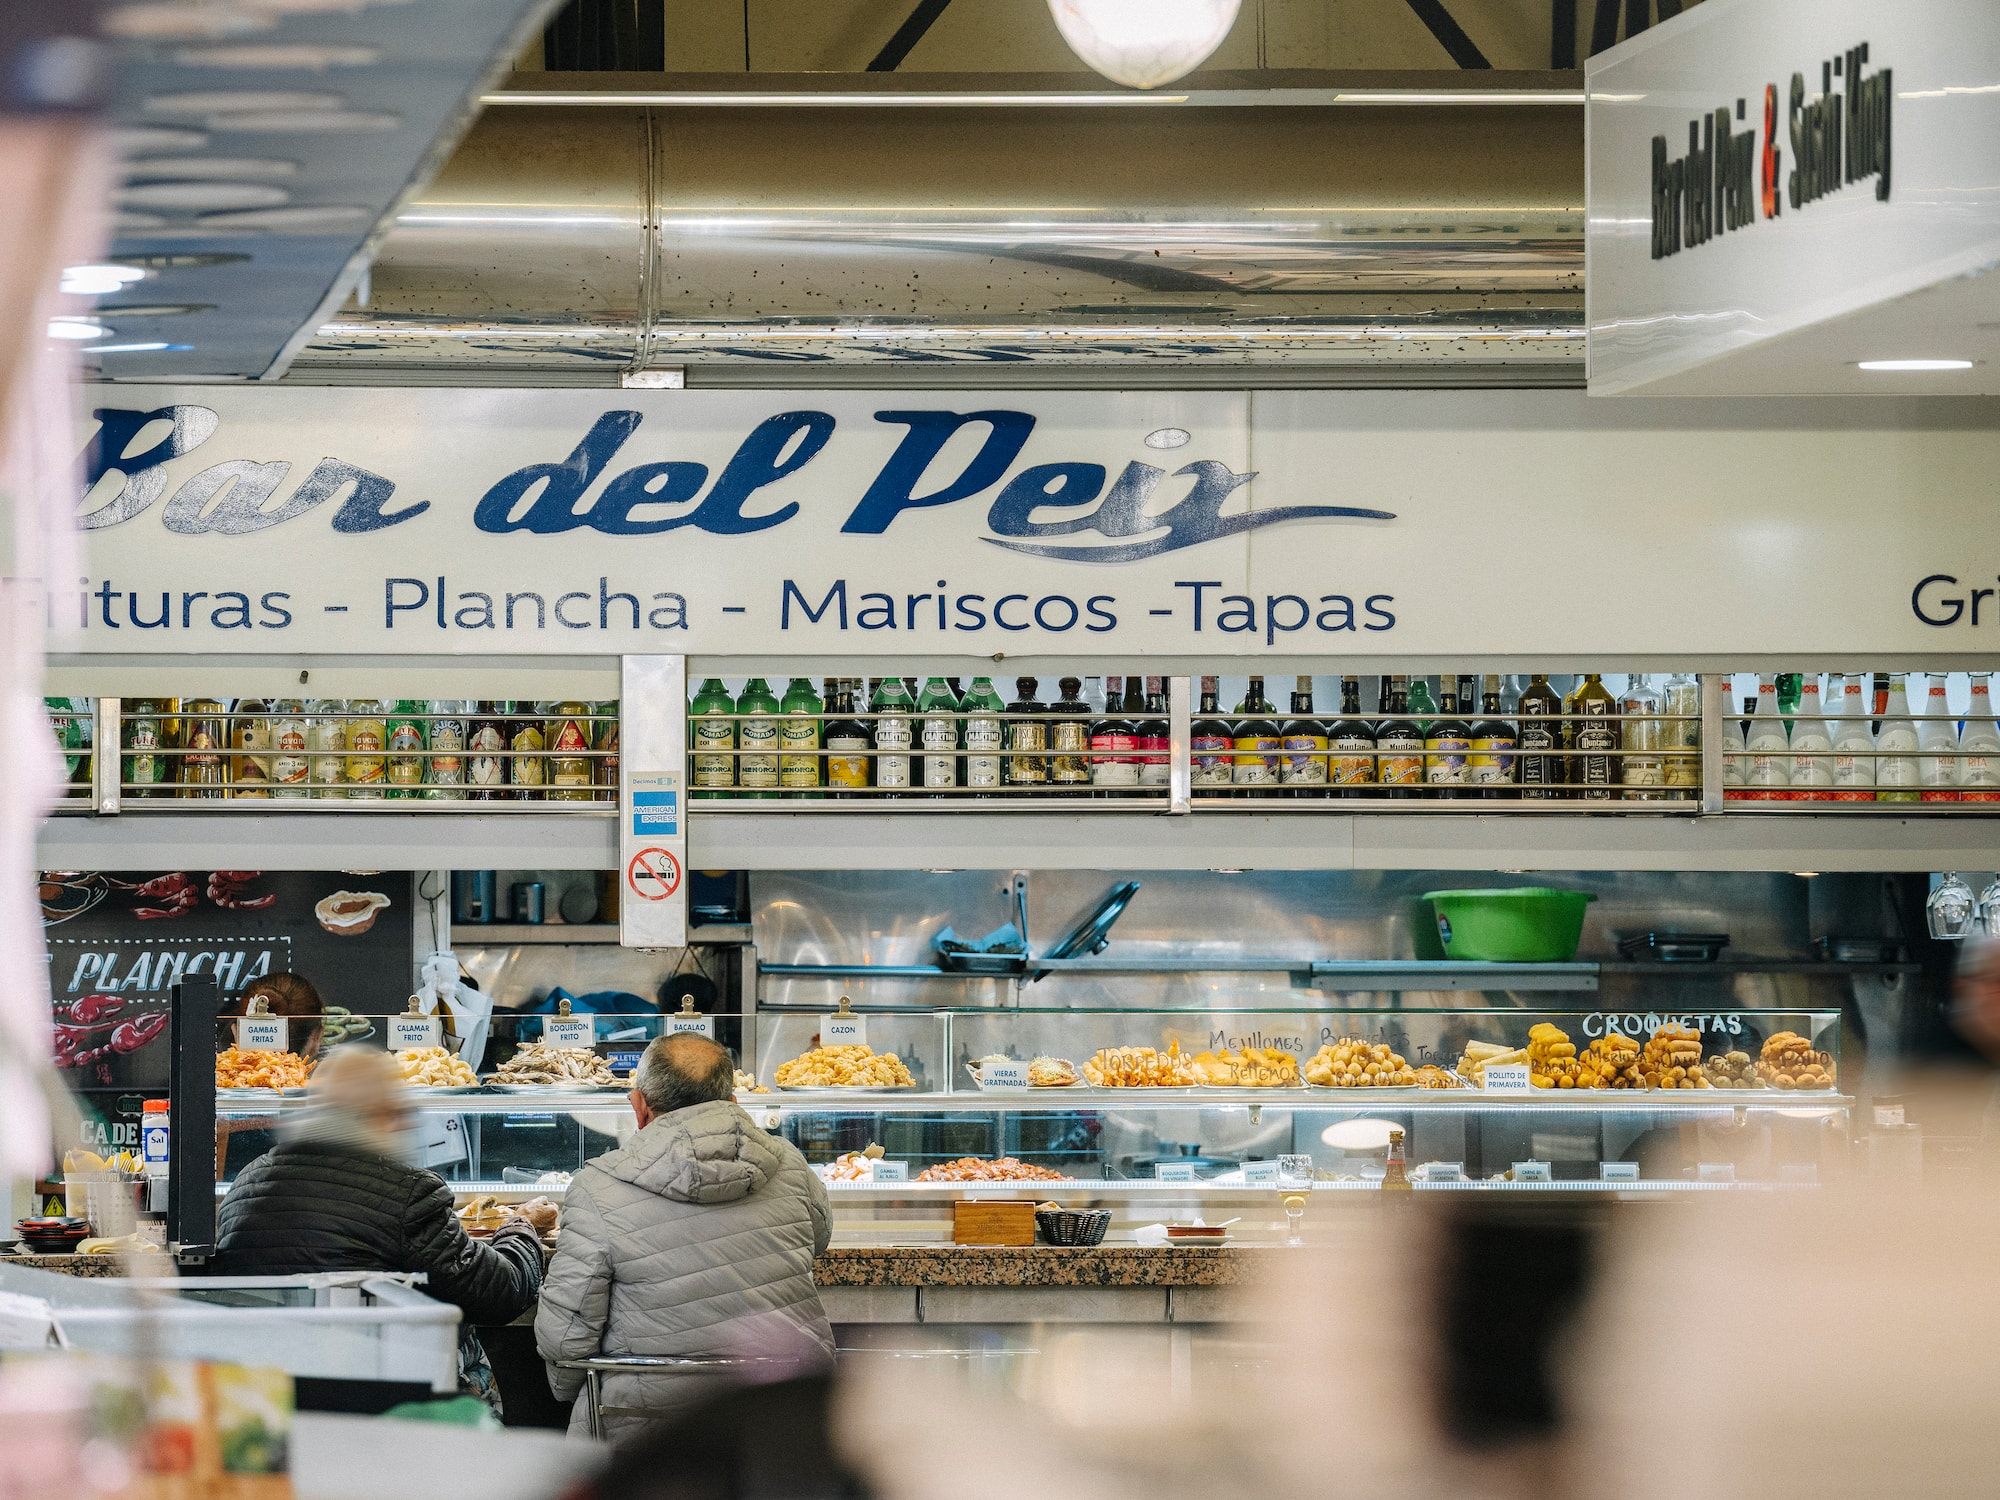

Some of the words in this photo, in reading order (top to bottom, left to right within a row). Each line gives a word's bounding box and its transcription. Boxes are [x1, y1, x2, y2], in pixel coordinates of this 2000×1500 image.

[1761, 82, 1781, 219] &
[73, 403, 430, 534] Bar
[473, 408, 837, 535] del
[839, 408, 1398, 564] Peix
[385, 576, 689, 631] Plancha
[780, 578, 1118, 632] Mariscos
[432, 720, 462, 738] BRUGAL
[878, 731, 910, 741] MARTINI
[925, 731, 956, 741] MARTINI
[968, 731, 999, 741] MARTINI
[1581, 738, 1612, 748] Muntaner
[1968, 757, 1988, 767] RITA
[67, 950, 272, 993] PLANCHA
[248, 1025, 278, 1035] GAMBAS
[397, 1024, 430, 1033] CALAMAR
[549, 1023, 589, 1033] BOQUERON
[673, 1023, 706, 1032] BACALAO
[830, 1026, 856, 1035] CAZON
[1582, 1011, 1742, 1040] CROQUETAS
[252, 1035, 274, 1044] FRITAS
[404, 1033, 423, 1042] FRITO
[560, 1032, 579, 1042] FRITO
[993, 1069, 1018, 1078] VIERAS
[983, 1078, 1028, 1088] GRATINADAS
[1488, 1081, 1527, 1089] PRIMAVERA
[112, 1122, 138, 1145] DE
